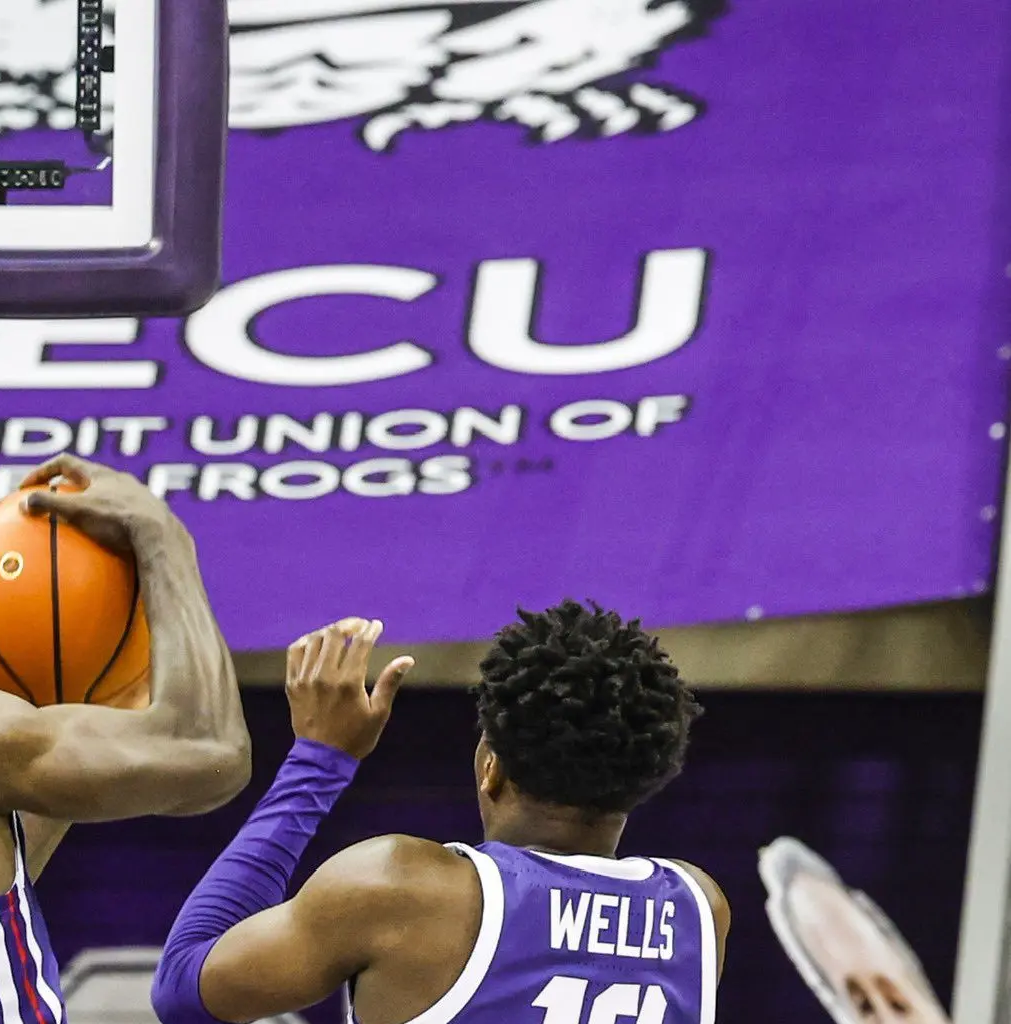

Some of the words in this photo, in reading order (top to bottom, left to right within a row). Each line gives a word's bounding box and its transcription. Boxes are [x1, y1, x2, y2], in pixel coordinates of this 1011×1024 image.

[190, 404, 522, 455] UNION
[550, 395, 687, 441] OF
[148, 455, 471, 501] FROGS
[550, 888, 675, 960] WELLS
